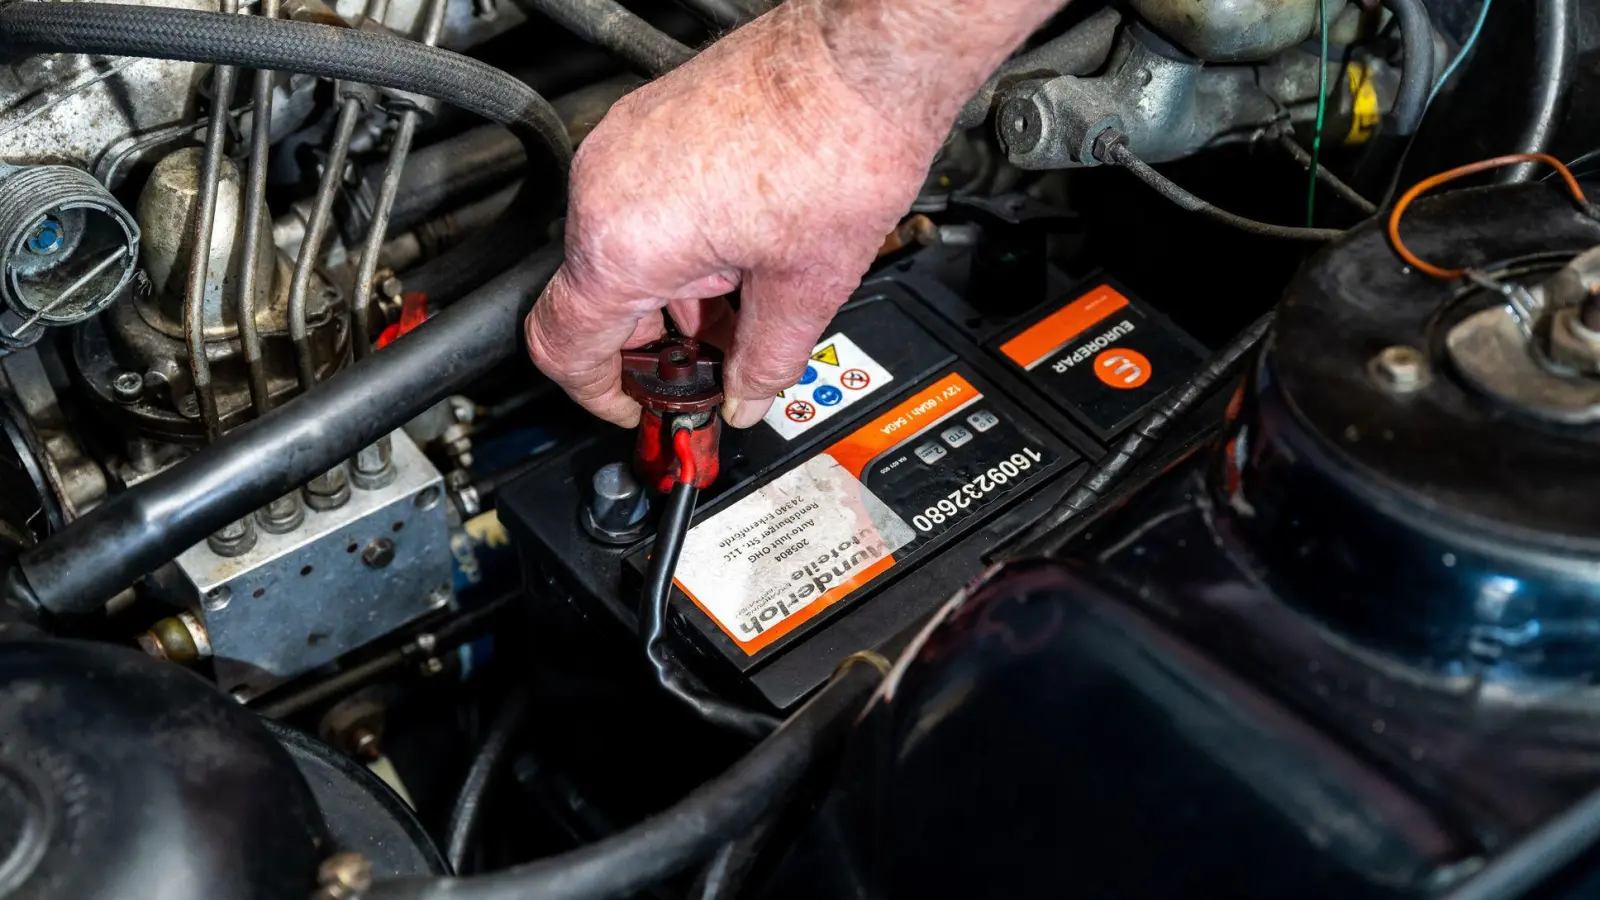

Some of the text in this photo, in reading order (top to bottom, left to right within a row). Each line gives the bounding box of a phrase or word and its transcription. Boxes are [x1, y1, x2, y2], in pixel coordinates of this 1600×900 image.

[1051, 319, 1135, 374] EUROREPAR
[942, 384, 961, 399] 12V
[910, 398, 937, 417] 60Ah
[879, 416, 907, 435] 540A
[948, 428, 966, 442] STD
[911, 446, 1043, 533] 1609232680
[718, 495, 803, 548] 24340 Eckernförde
[759, 500, 818, 538] Rendsburger
[742, 536, 760, 549] Str.
[774, 538, 809, 562] 205804
[747, 545, 770, 563] OHG
